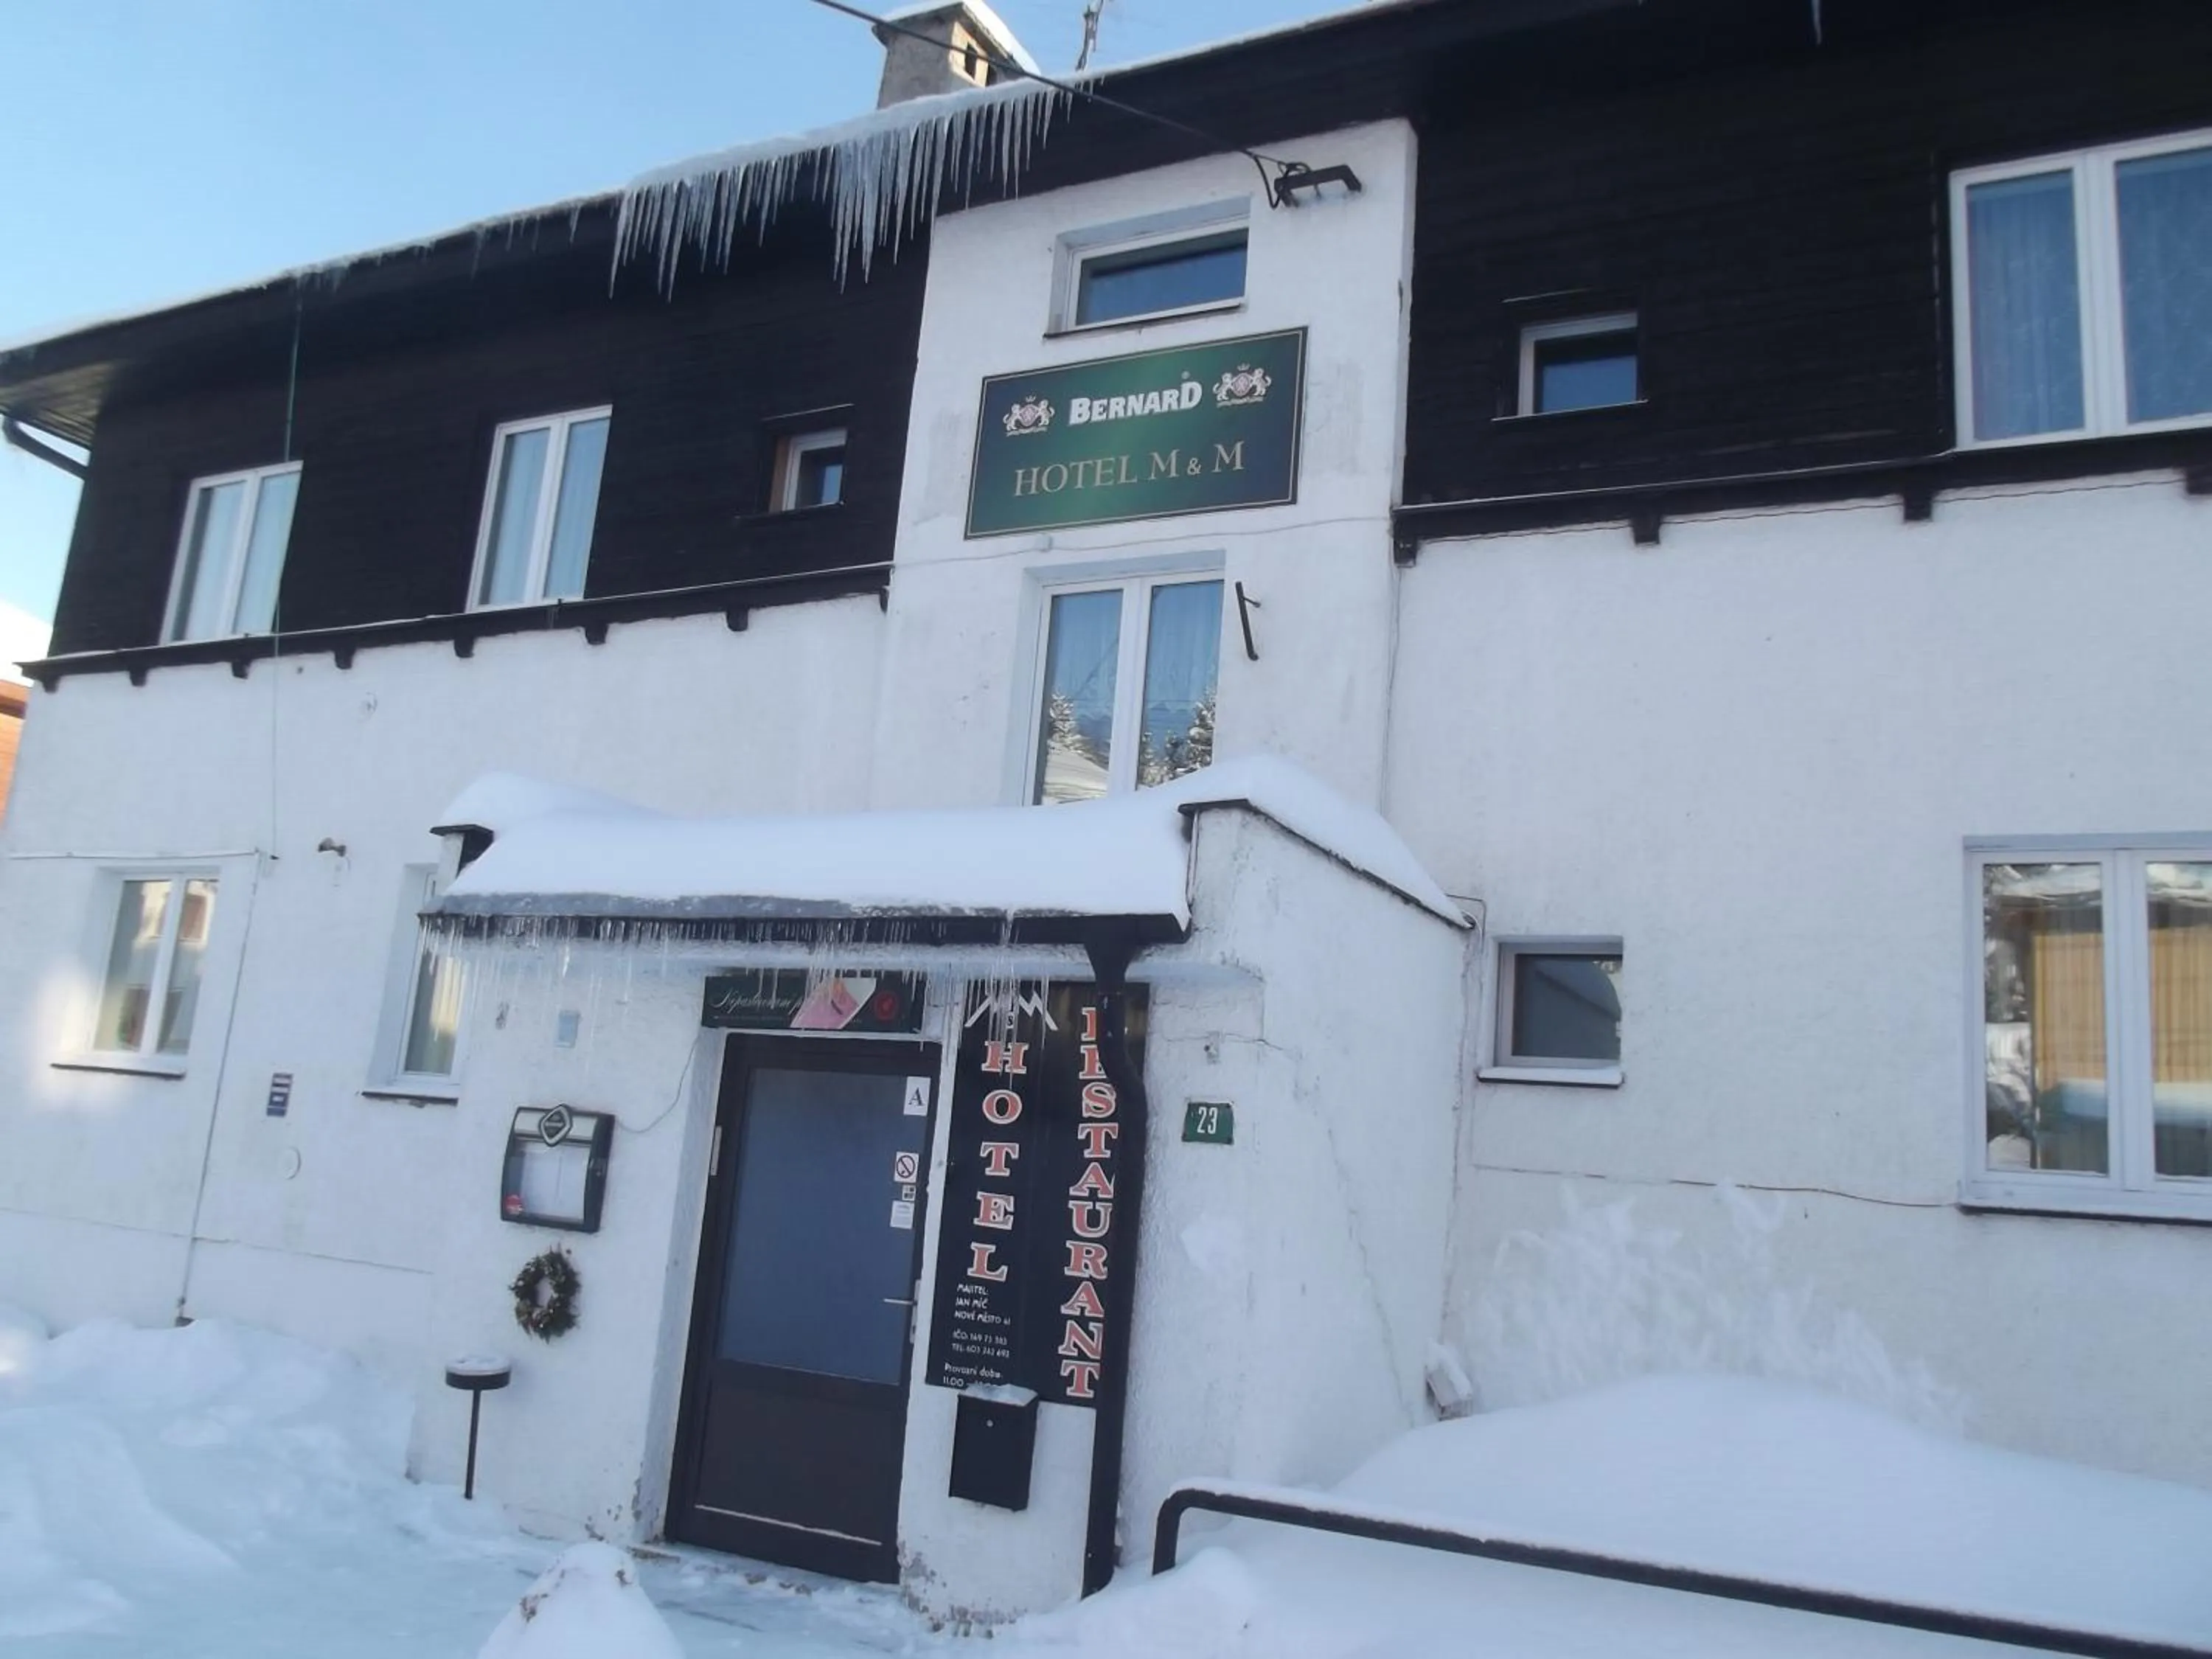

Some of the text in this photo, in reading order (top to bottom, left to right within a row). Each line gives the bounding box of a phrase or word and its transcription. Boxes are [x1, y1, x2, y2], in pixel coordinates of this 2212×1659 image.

[1068, 380, 1203, 425] BERNARD
[1012, 441, 1245, 497] HOTEL M & M
[908, 1086, 927, 1107] A
[1197, 1106, 1218, 1134] 23
[967, 1039, 1030, 1282] HOTEL
